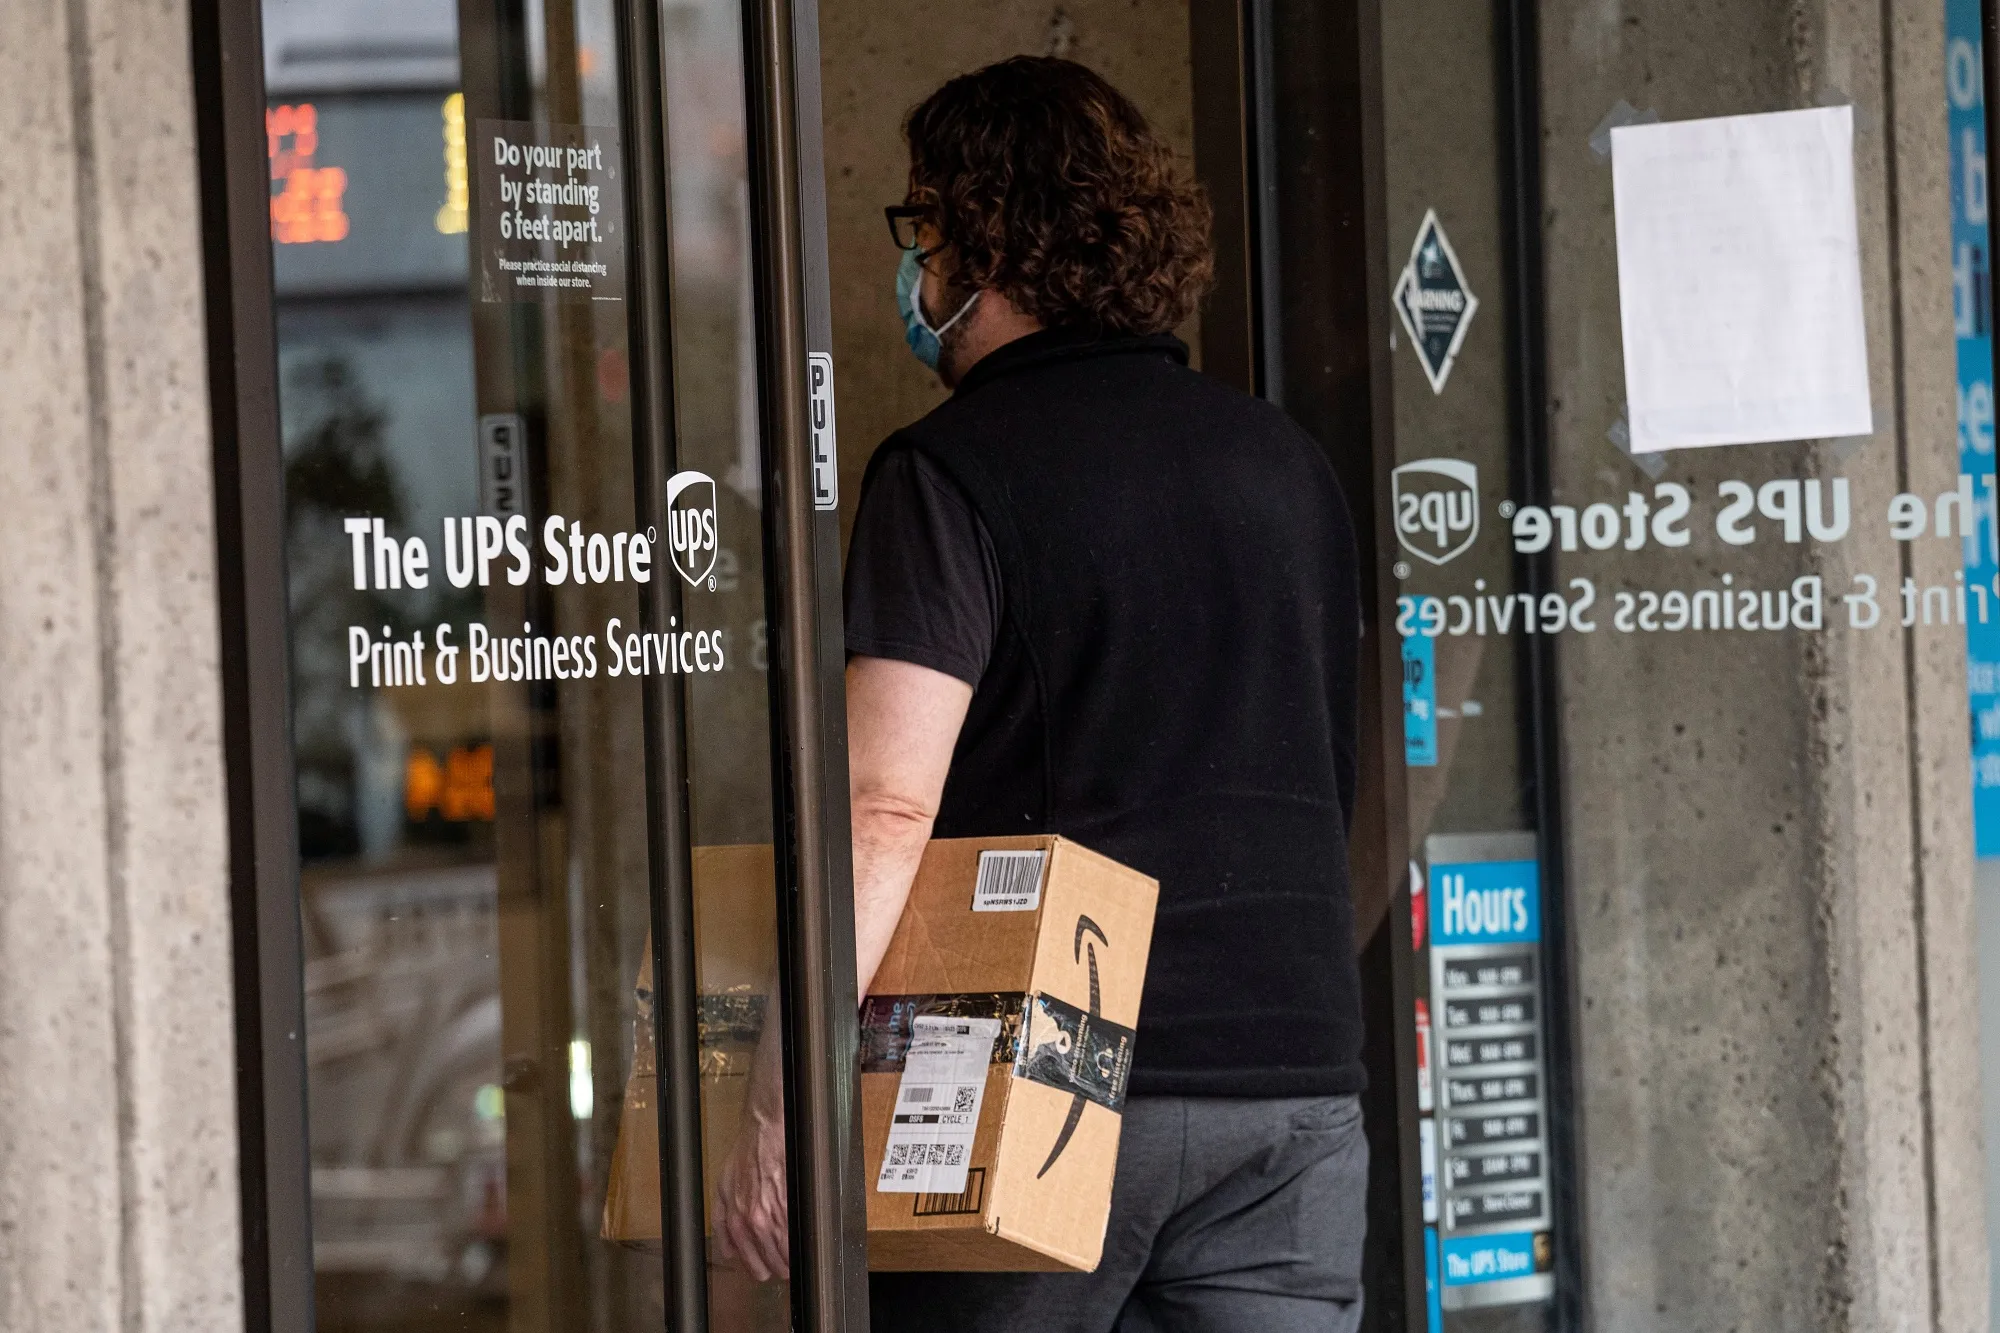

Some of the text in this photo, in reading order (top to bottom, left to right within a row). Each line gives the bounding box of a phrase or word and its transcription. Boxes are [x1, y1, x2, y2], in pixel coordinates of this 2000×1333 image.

[494, 137, 602, 176] Do your part
[500, 174, 600, 214] by standing
[500, 211, 602, 249] 6 feet apart.
[499, 258, 607, 276] Please practice social distancing
[516, 275, 592, 288] when inside our store.
[810, 364, 829, 498] PULL
[344, 517, 429, 591] The
[444, 514, 531, 588] UPS
[671, 508, 715, 568] ups
[348, 615, 724, 688] Print & Business Services
[1442, 873, 1528, 936] Hours
[1073, 1014, 1089, 1057] streaming
[1112, 1036, 1128, 1077] listening
[1447, 1248, 1530, 1278] The UPS Store
